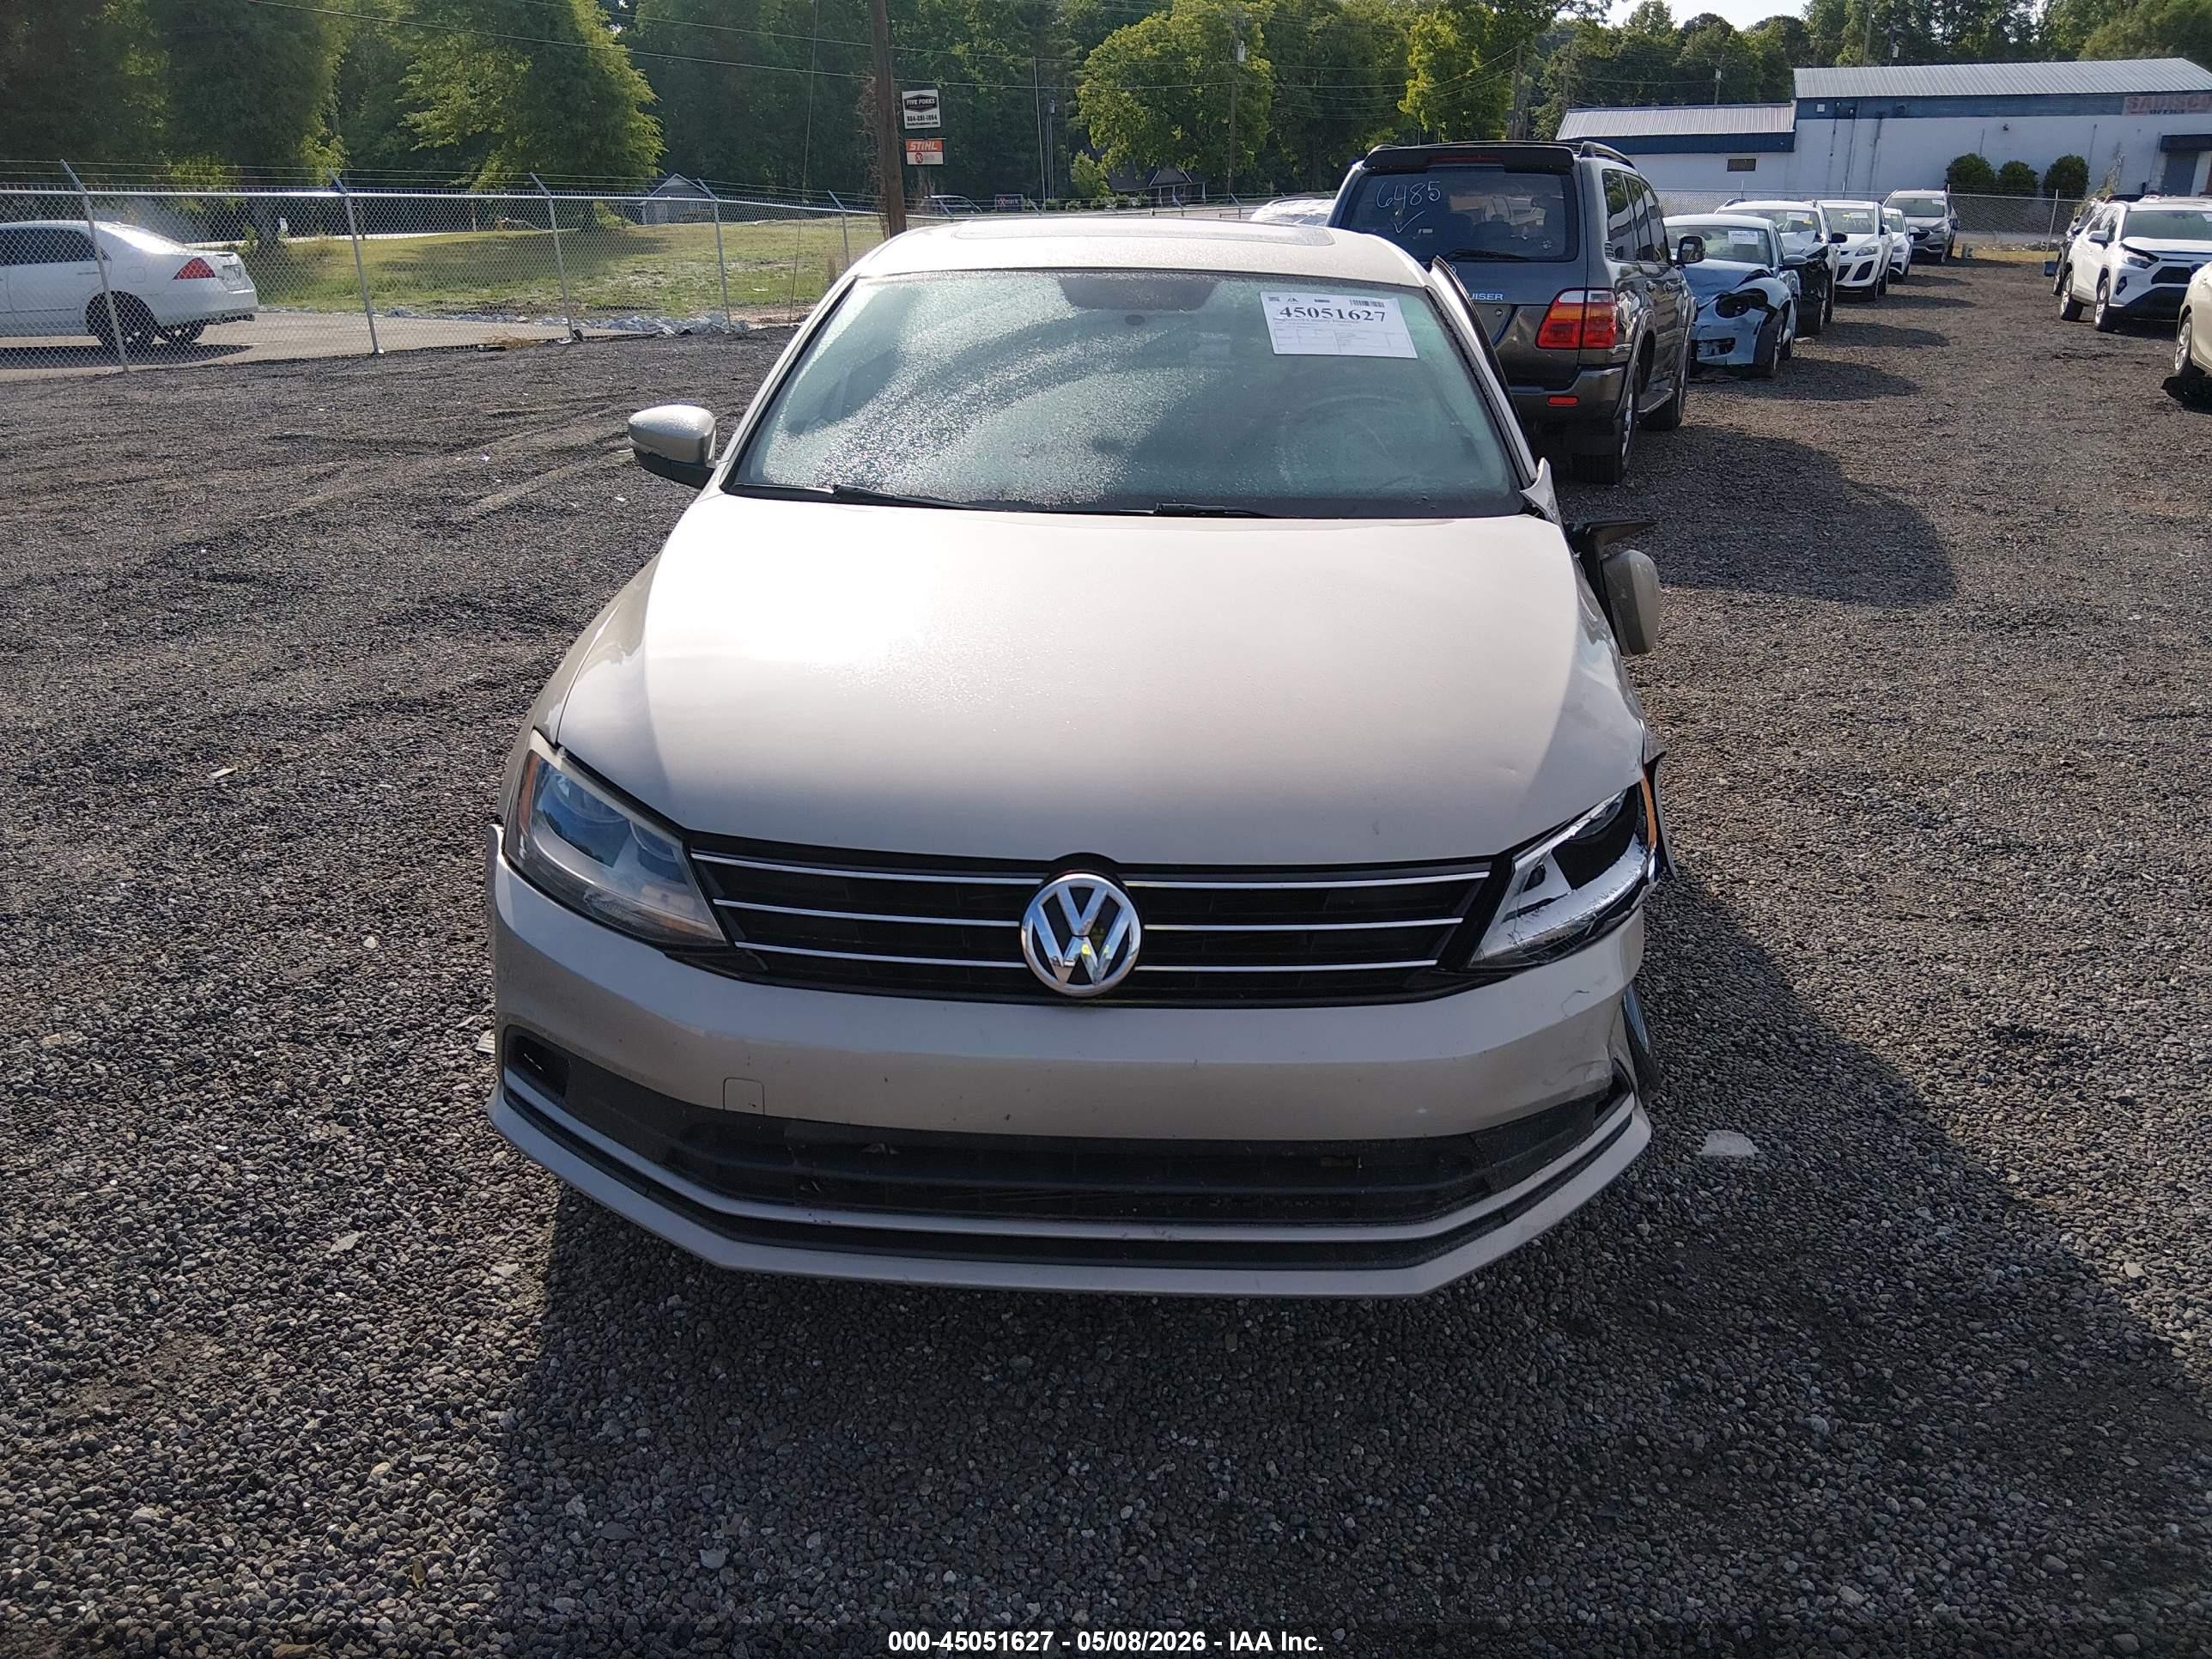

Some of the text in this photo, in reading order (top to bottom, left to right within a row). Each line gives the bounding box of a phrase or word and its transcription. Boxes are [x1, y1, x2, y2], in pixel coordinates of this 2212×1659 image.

[909, 140, 938, 151] STIHL
[1376, 180, 1441, 209] 6485
[1279, 306, 1386, 323] 45051627
